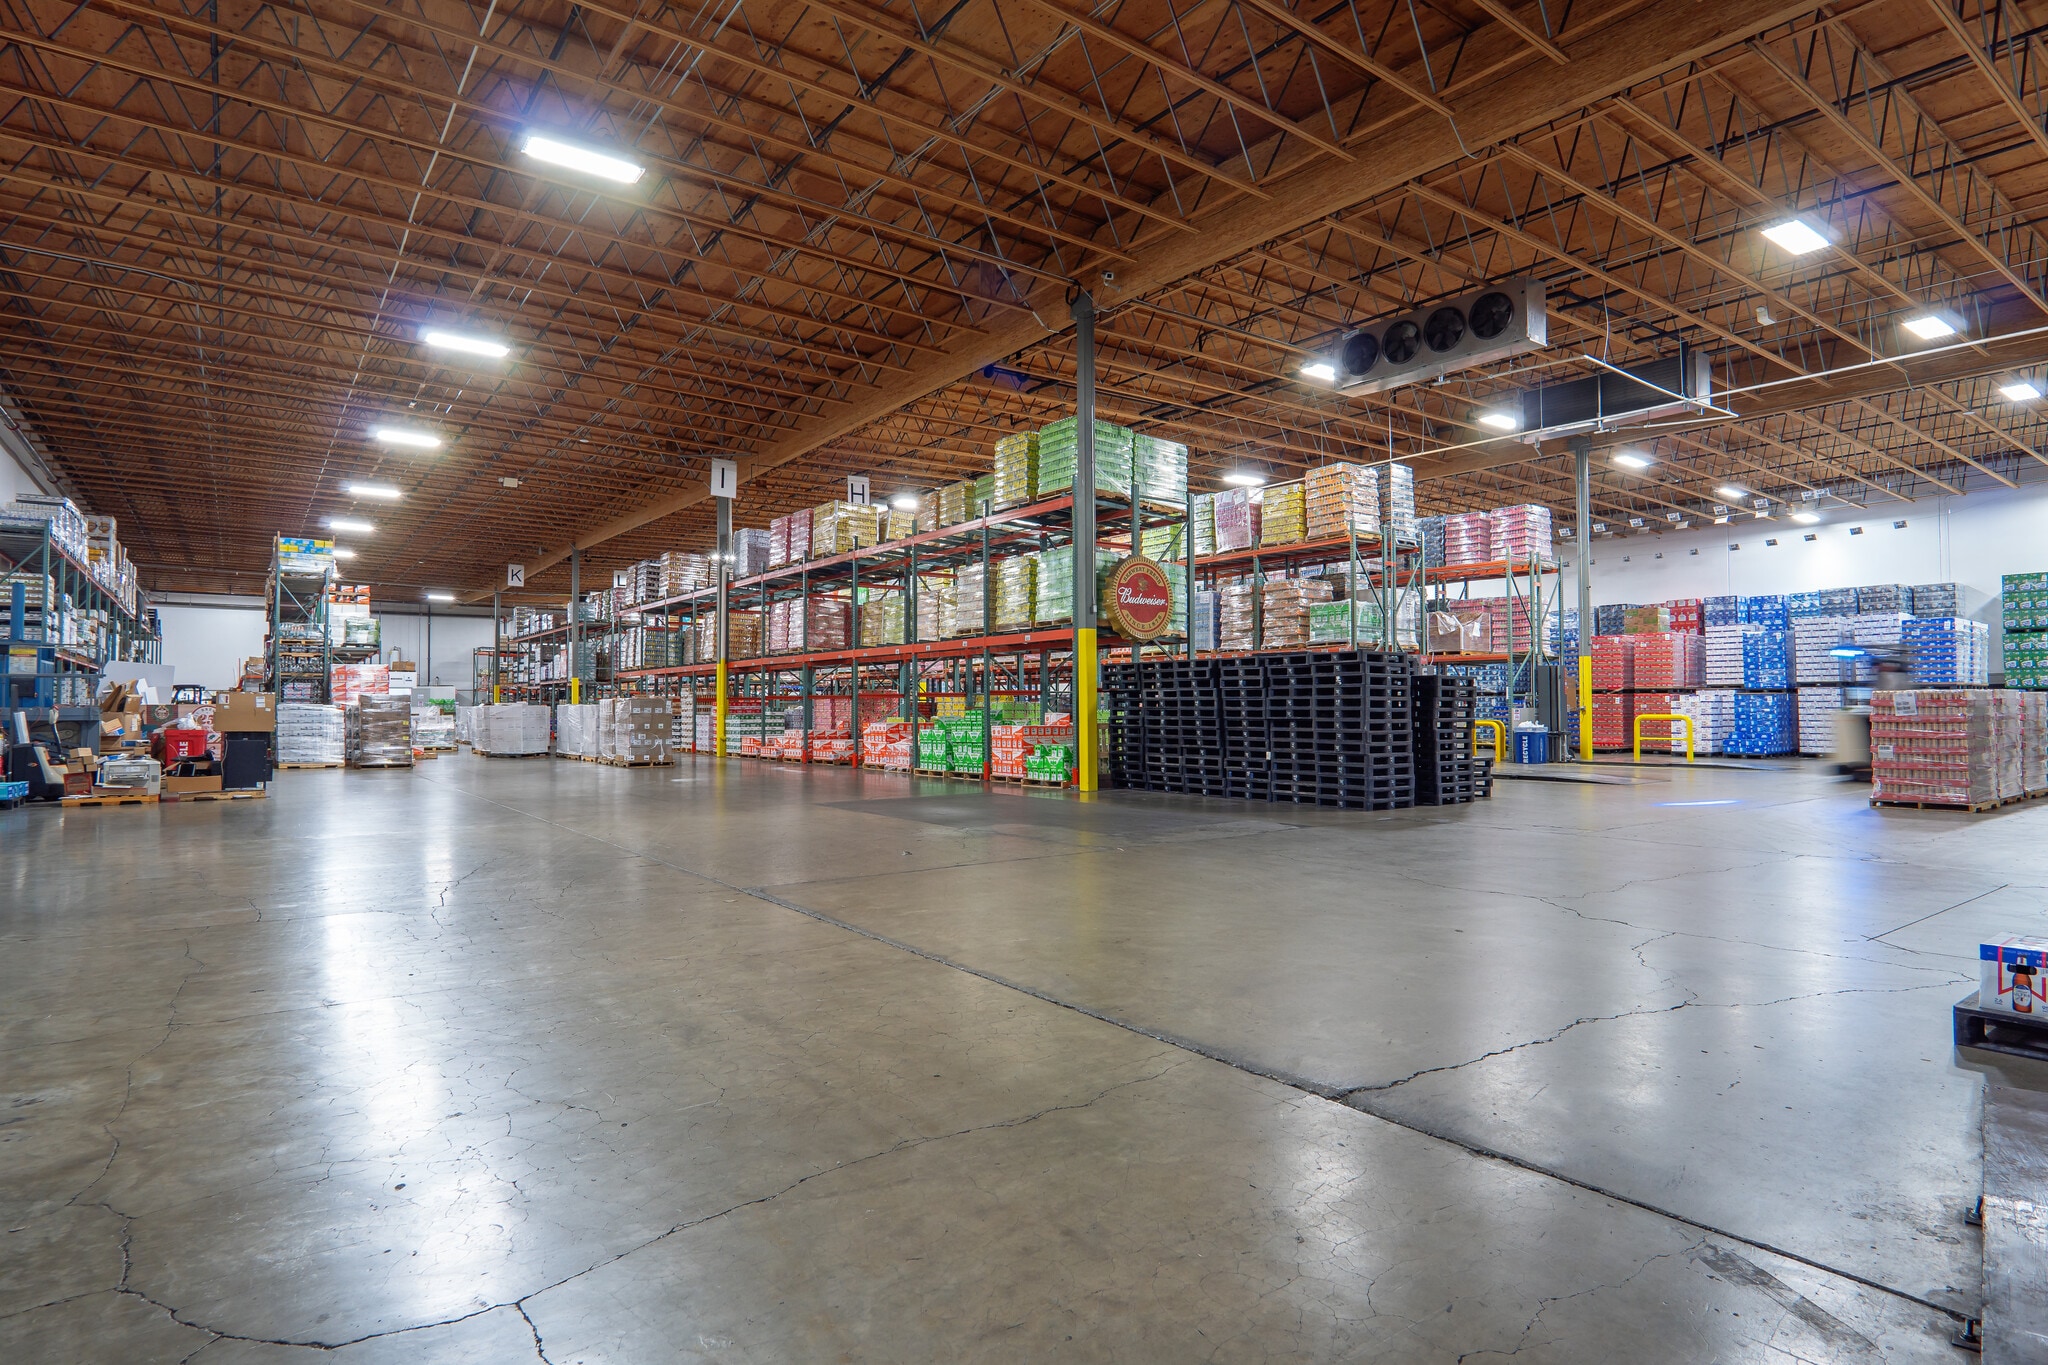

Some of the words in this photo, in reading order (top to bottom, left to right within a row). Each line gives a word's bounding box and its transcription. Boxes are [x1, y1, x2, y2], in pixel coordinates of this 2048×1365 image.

[850, 483, 865, 503] H
[511, 568, 522, 582] K
[617, 574, 626, 587] L
